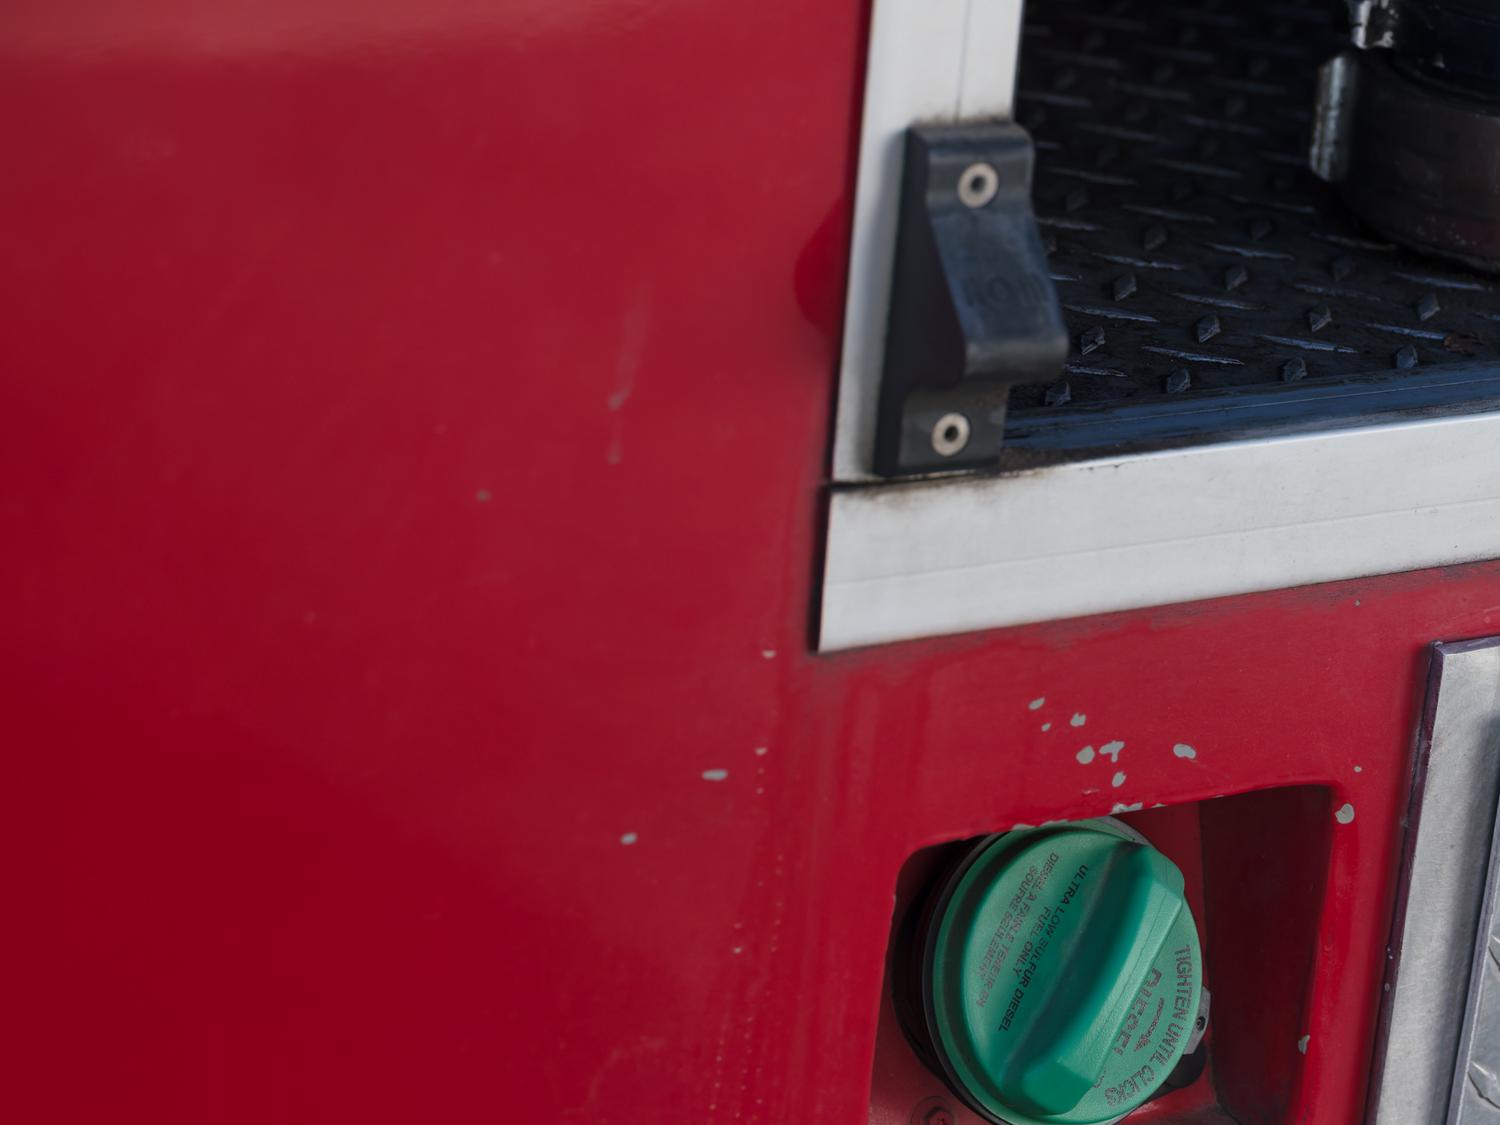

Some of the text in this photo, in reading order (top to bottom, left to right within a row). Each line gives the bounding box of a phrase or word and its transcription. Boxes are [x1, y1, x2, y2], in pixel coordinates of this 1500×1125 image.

[1009, 866, 1038, 911] SOUFRE
[1013, 906, 1052, 976] FUEL ONLY
[998, 864, 1089, 1032] ULTRA LOW SULFUR DIESEL
[1104, 944, 1193, 1107] TIGHTEN UNTIL CLICKS
